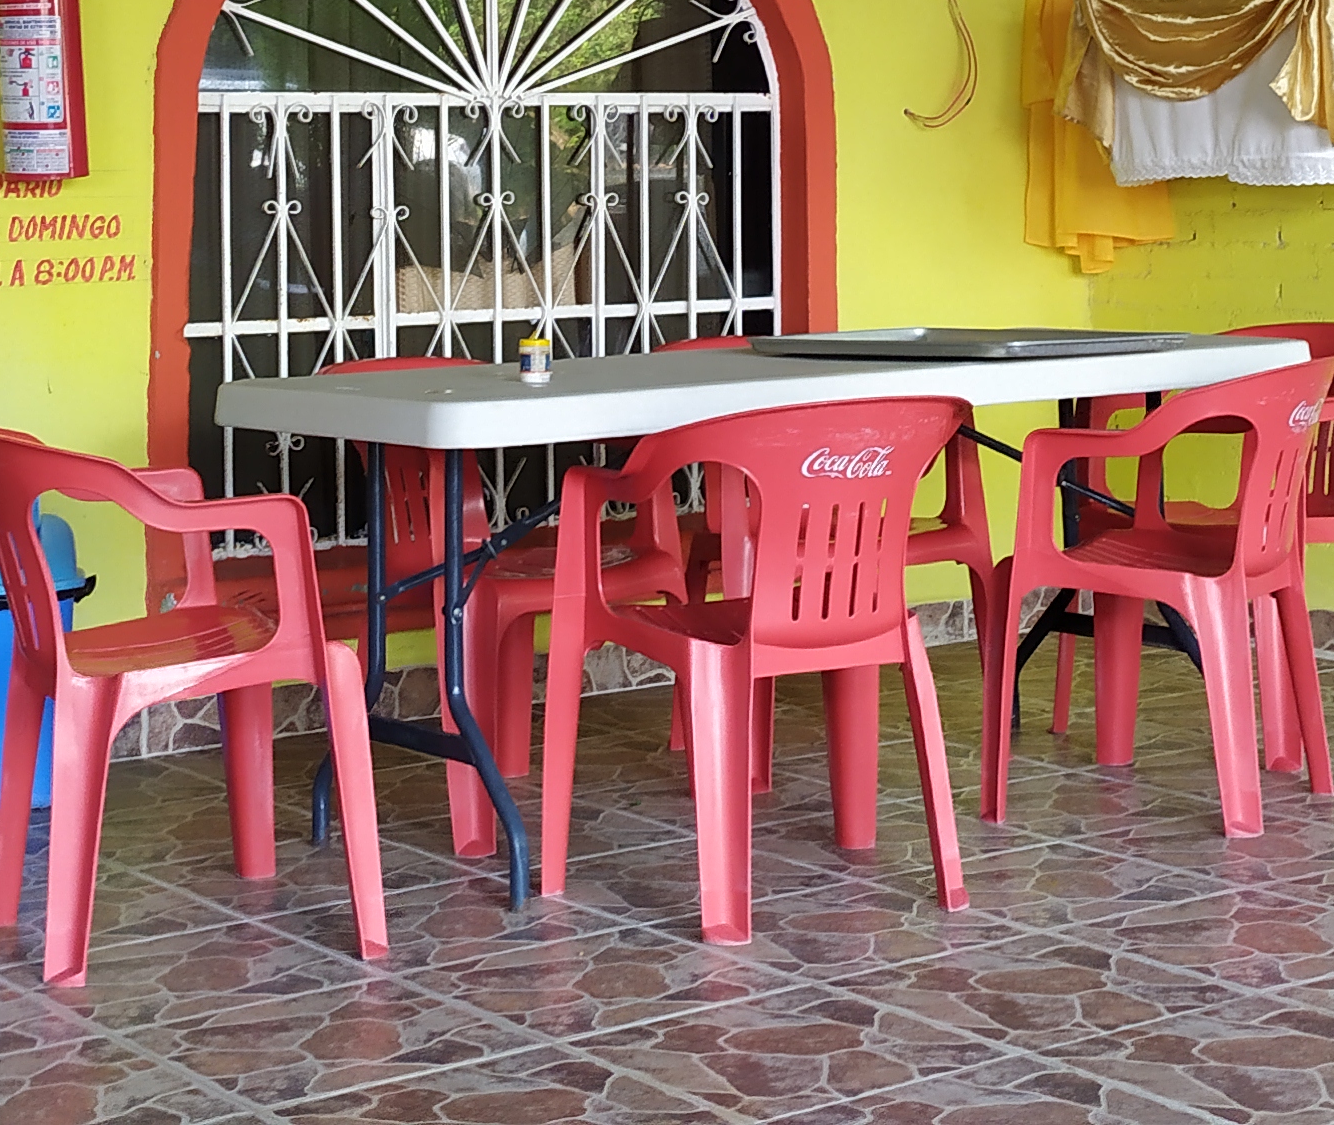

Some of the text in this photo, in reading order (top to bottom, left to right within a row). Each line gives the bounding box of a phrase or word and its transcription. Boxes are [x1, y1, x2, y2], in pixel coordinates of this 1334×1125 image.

[8, 214, 122, 242] DOMINGO
[10, 259, 25, 287] A
[800, 445, 895, 479] Coca-Cola
